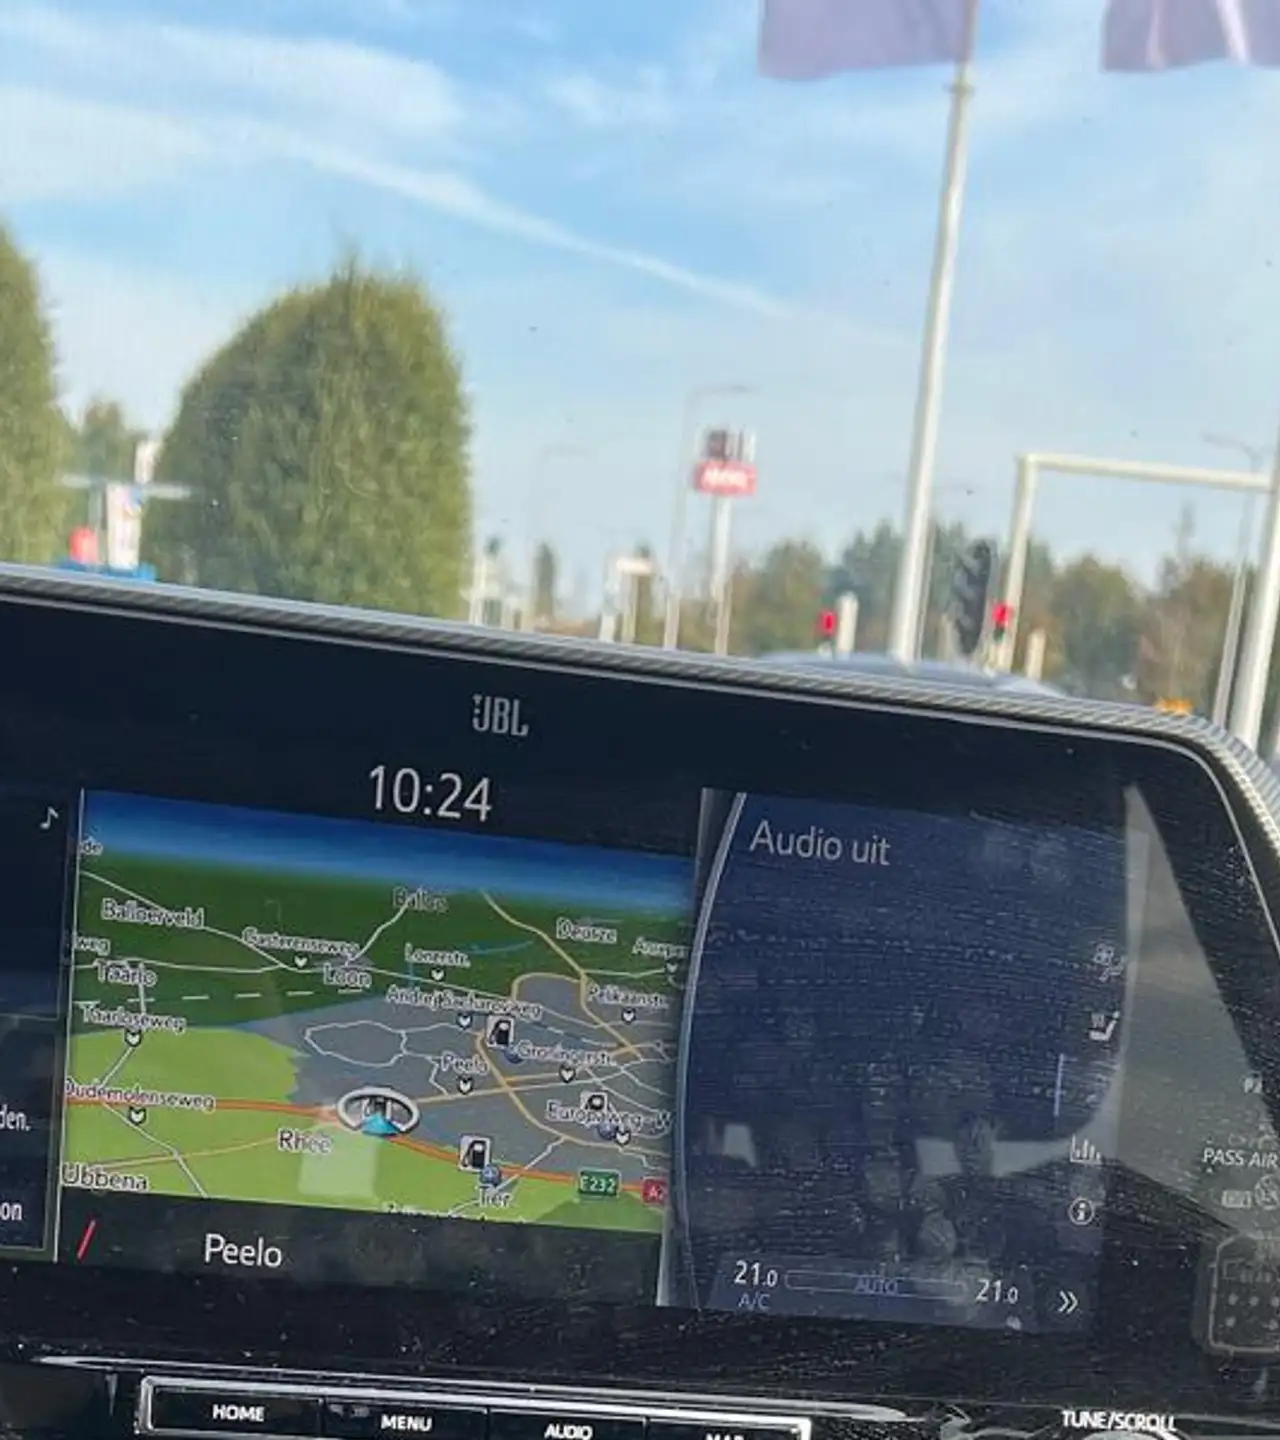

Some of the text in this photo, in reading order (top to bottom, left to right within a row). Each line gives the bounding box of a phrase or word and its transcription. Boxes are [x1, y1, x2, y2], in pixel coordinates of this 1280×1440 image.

[472, 694, 529, 737] JBL
[369, 764, 493, 823] 10:24
[749, 820, 890, 866] Audio uit
[323, 963, 372, 988] Loon
[277, 1128, 332, 1154] Rhee
[1203, 1147, 1244, 1168] PASS
[1248, 1150, 1278, 1171] AIR
[62, 1163, 149, 1191] Ubbena
[579, 1173, 618, 1196] E232
[203, 1232, 283, 1268] Peelo
[733, 1261, 779, 1289] 21.0
[211, 1402, 266, 1424] HOME
[380, 1411, 433, 1433] MENU
[1061, 1409, 1178, 1434] TUNE/SCROLL
